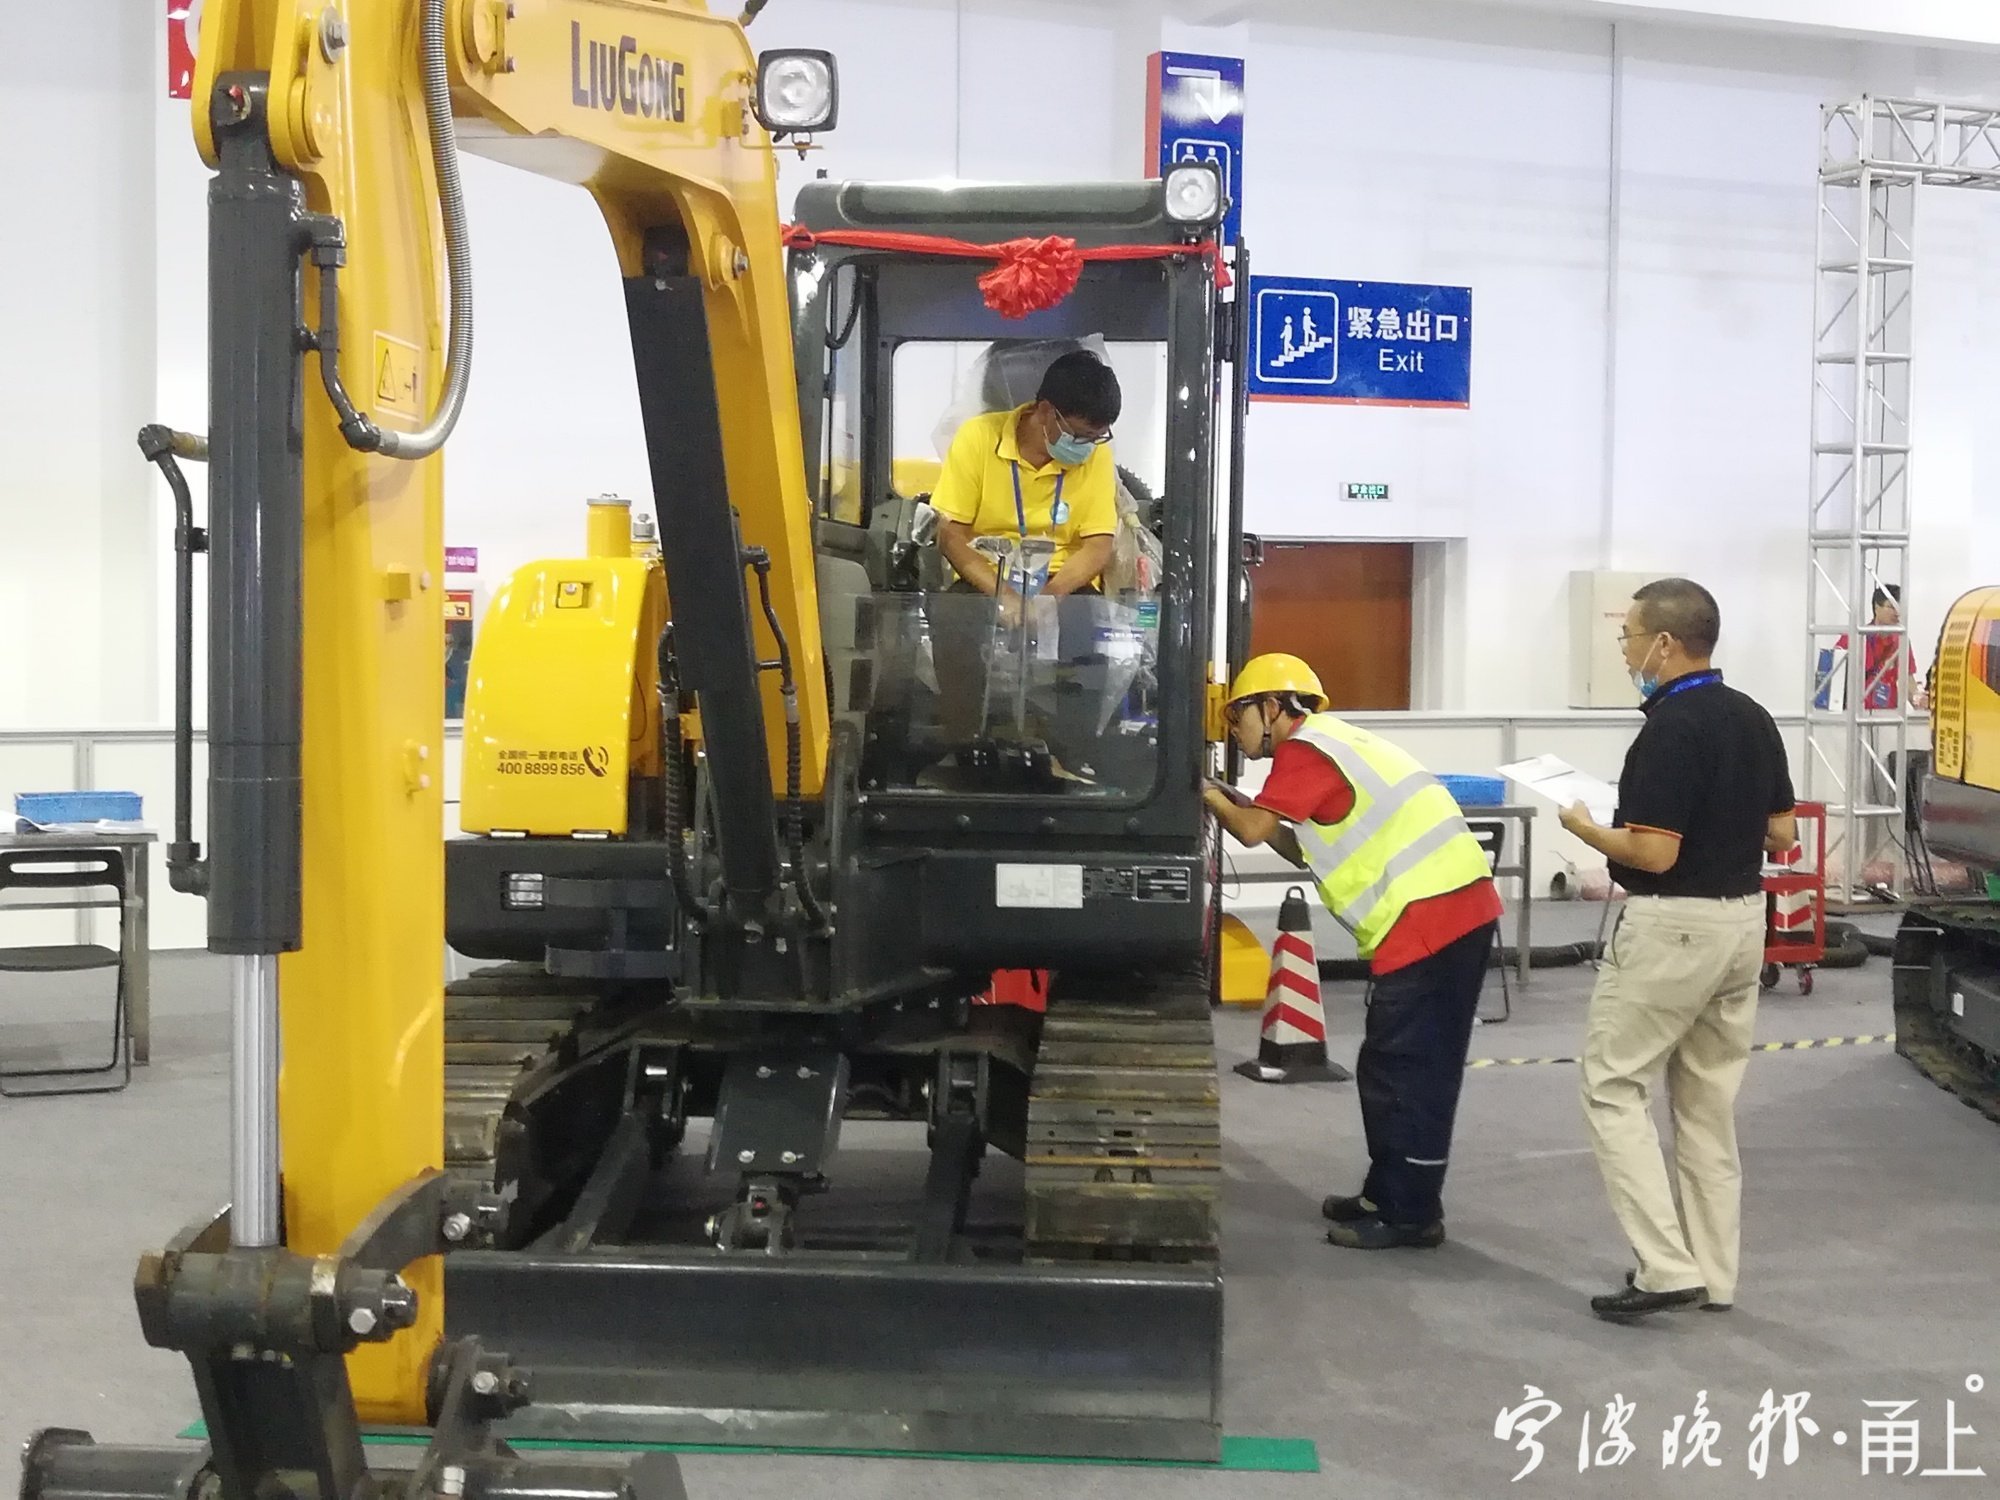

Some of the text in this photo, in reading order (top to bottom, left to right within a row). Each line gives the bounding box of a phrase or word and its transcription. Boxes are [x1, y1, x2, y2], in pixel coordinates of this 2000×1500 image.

[571, 20, 685, 123] LIUGONG
[1347, 306, 1458, 342] 紧急出口
[1379, 348, 1424, 373] Exit
[497, 762, 586, 776] 400 8899 856
